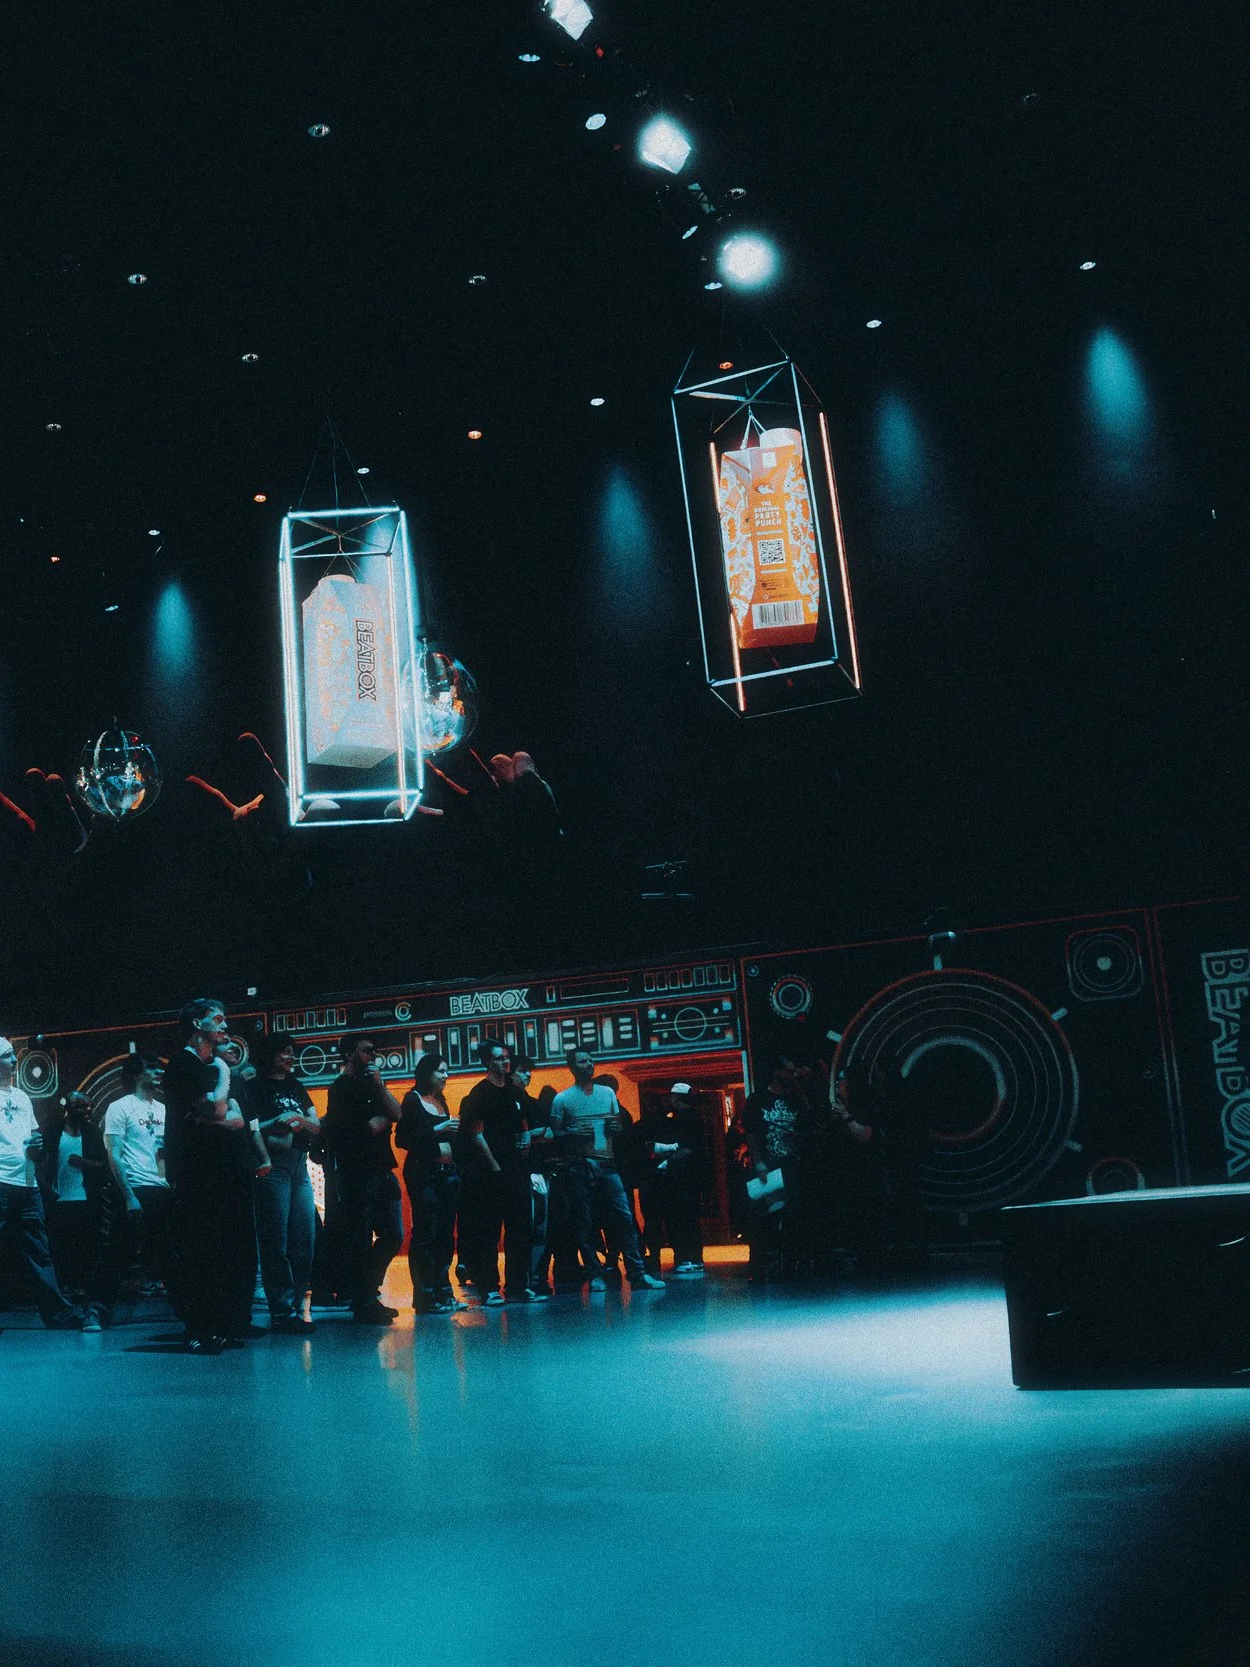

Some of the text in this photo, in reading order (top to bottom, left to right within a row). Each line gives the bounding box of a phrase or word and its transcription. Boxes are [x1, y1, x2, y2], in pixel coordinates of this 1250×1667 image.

[754, 510, 780, 519] PARTY
[755, 518, 782, 527] PUNCH
[356, 619, 377, 701] BEATBOX
[449, 989, 530, 1016] BEATBOX
